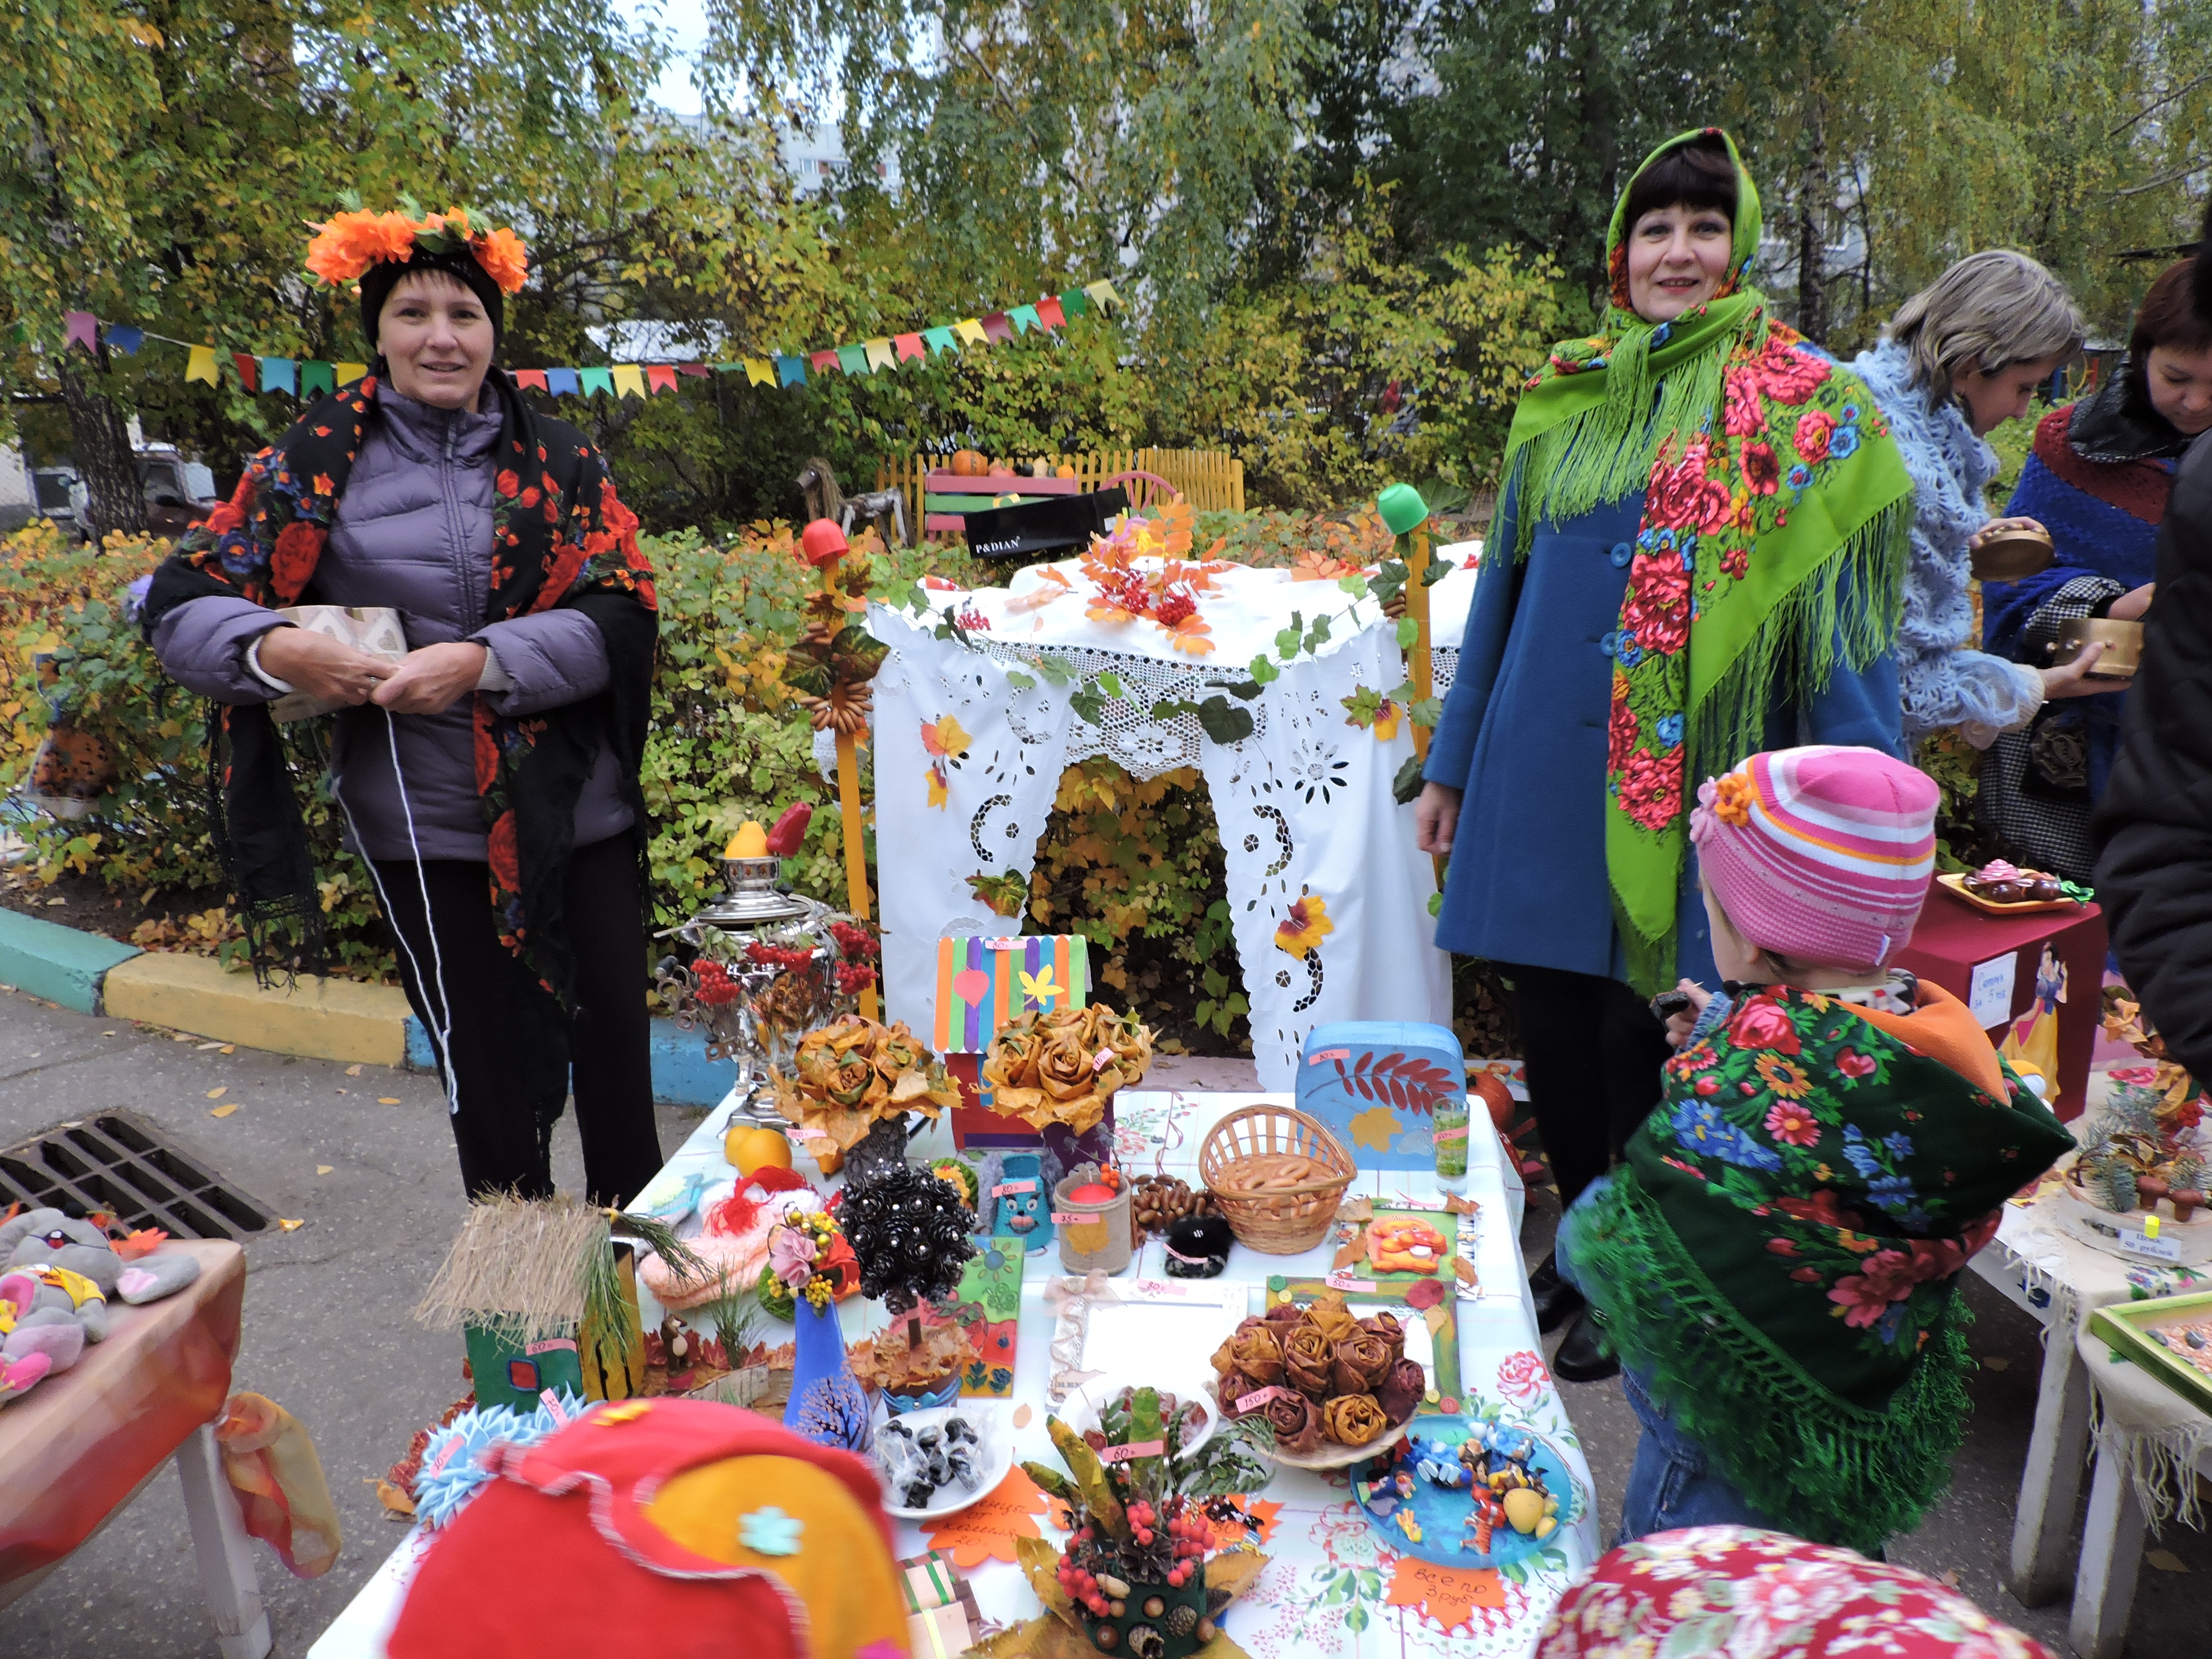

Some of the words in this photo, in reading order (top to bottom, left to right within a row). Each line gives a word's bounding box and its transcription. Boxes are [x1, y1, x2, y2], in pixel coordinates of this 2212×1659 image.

[975, 539, 1019, 554] P&DIAN
[1426, 1585, 1437, 1597] 3
[1460, 1582, 1487, 1594] по
